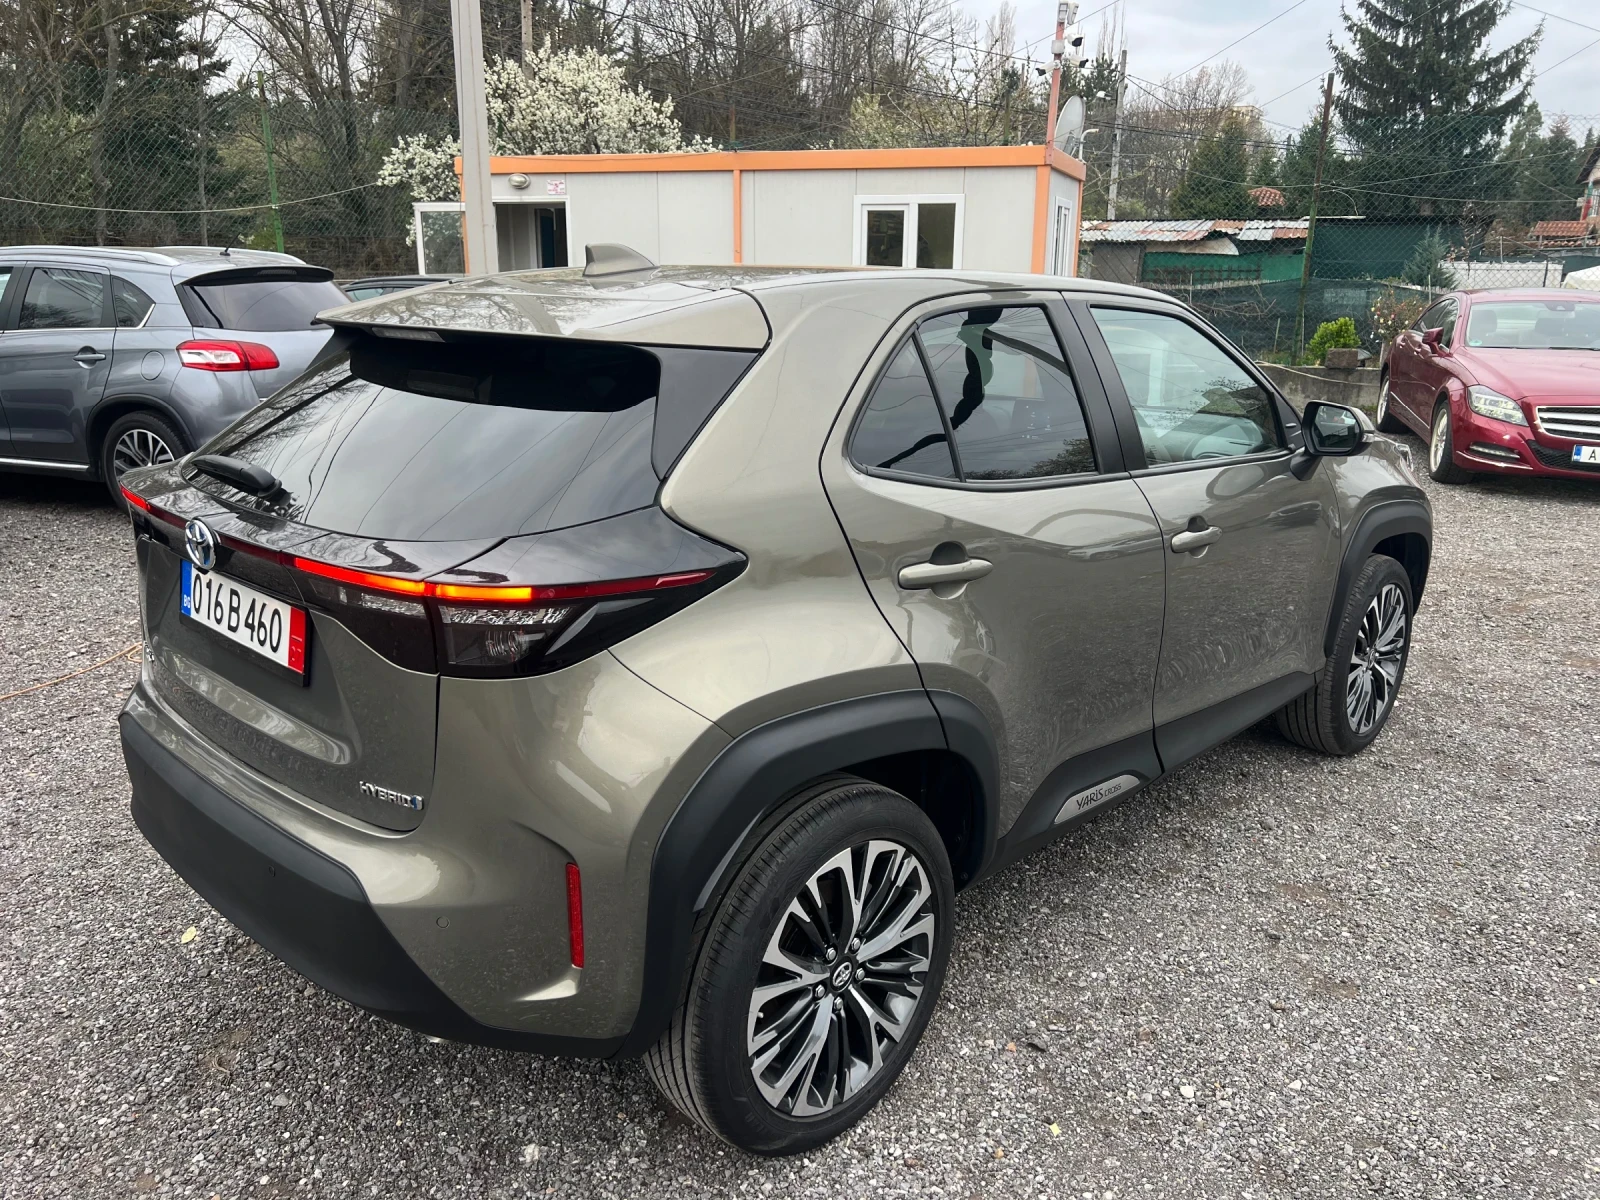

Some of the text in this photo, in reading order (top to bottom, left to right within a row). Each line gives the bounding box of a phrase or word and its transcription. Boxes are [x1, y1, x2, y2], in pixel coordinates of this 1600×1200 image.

[183, 594, 191, 609] BG
[359, 780, 411, 808] HYBRID
[1104, 783, 1122, 797] CROSS
